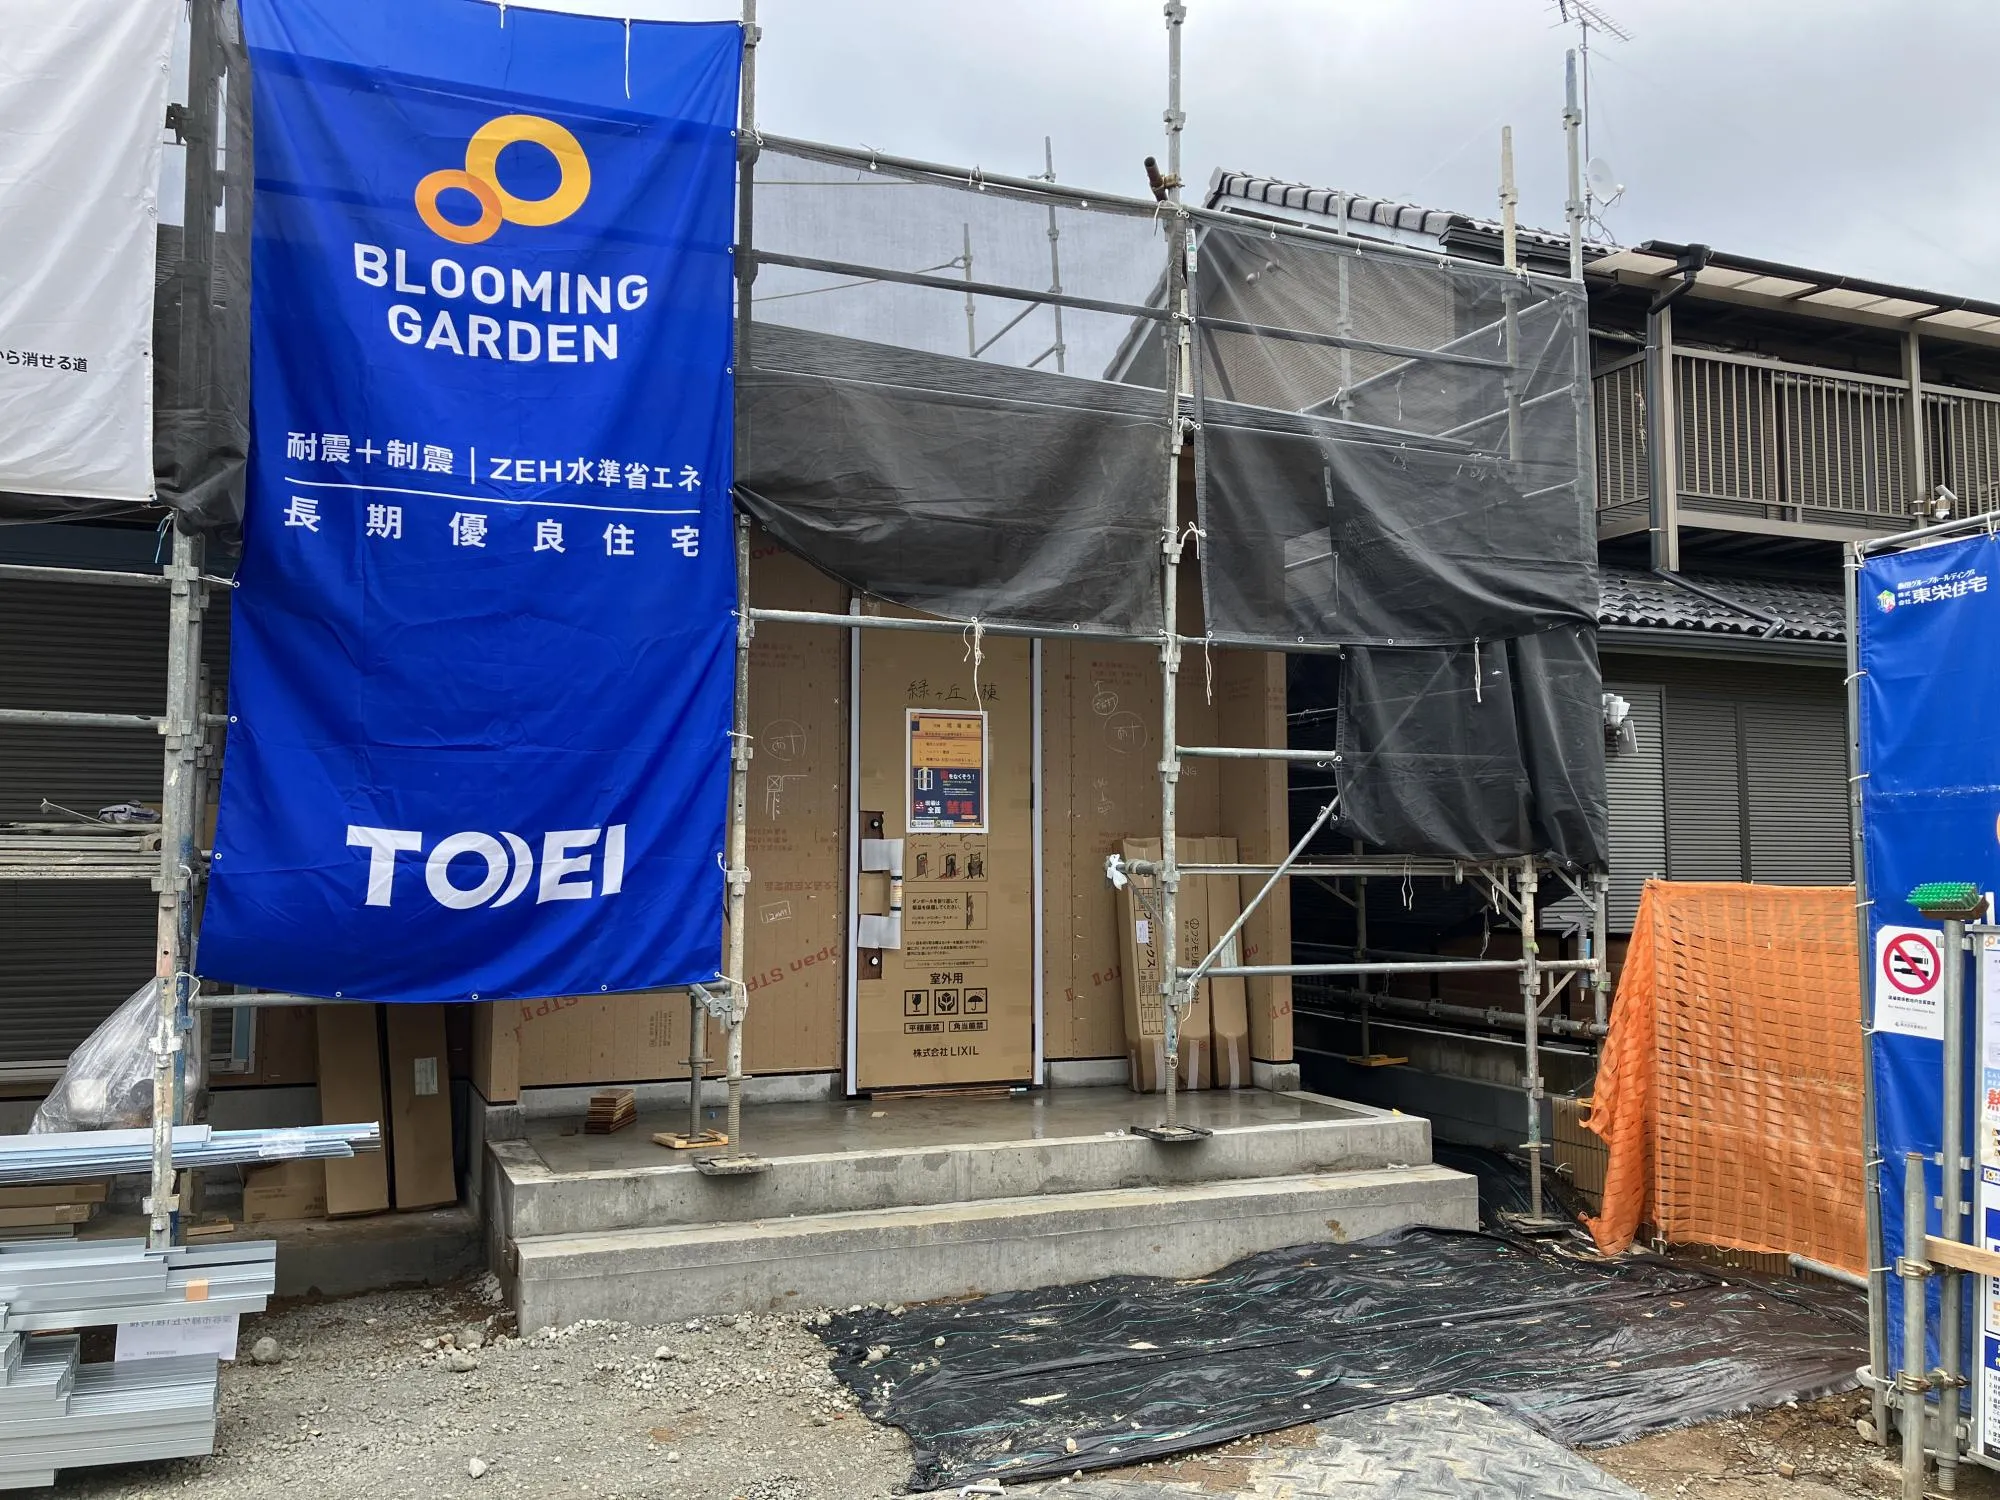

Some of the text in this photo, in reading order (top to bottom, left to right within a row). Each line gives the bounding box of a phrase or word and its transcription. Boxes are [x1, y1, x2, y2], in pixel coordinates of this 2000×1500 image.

[354, 242, 648, 315] BLOOMING
[387, 303, 619, 364] GARDEN
[1912, 576, 1988, 604] 東栄住宅
[929, 972, 964, 985] 室外用
[912, 1045, 980, 1058] 株式会社 LIXIL
